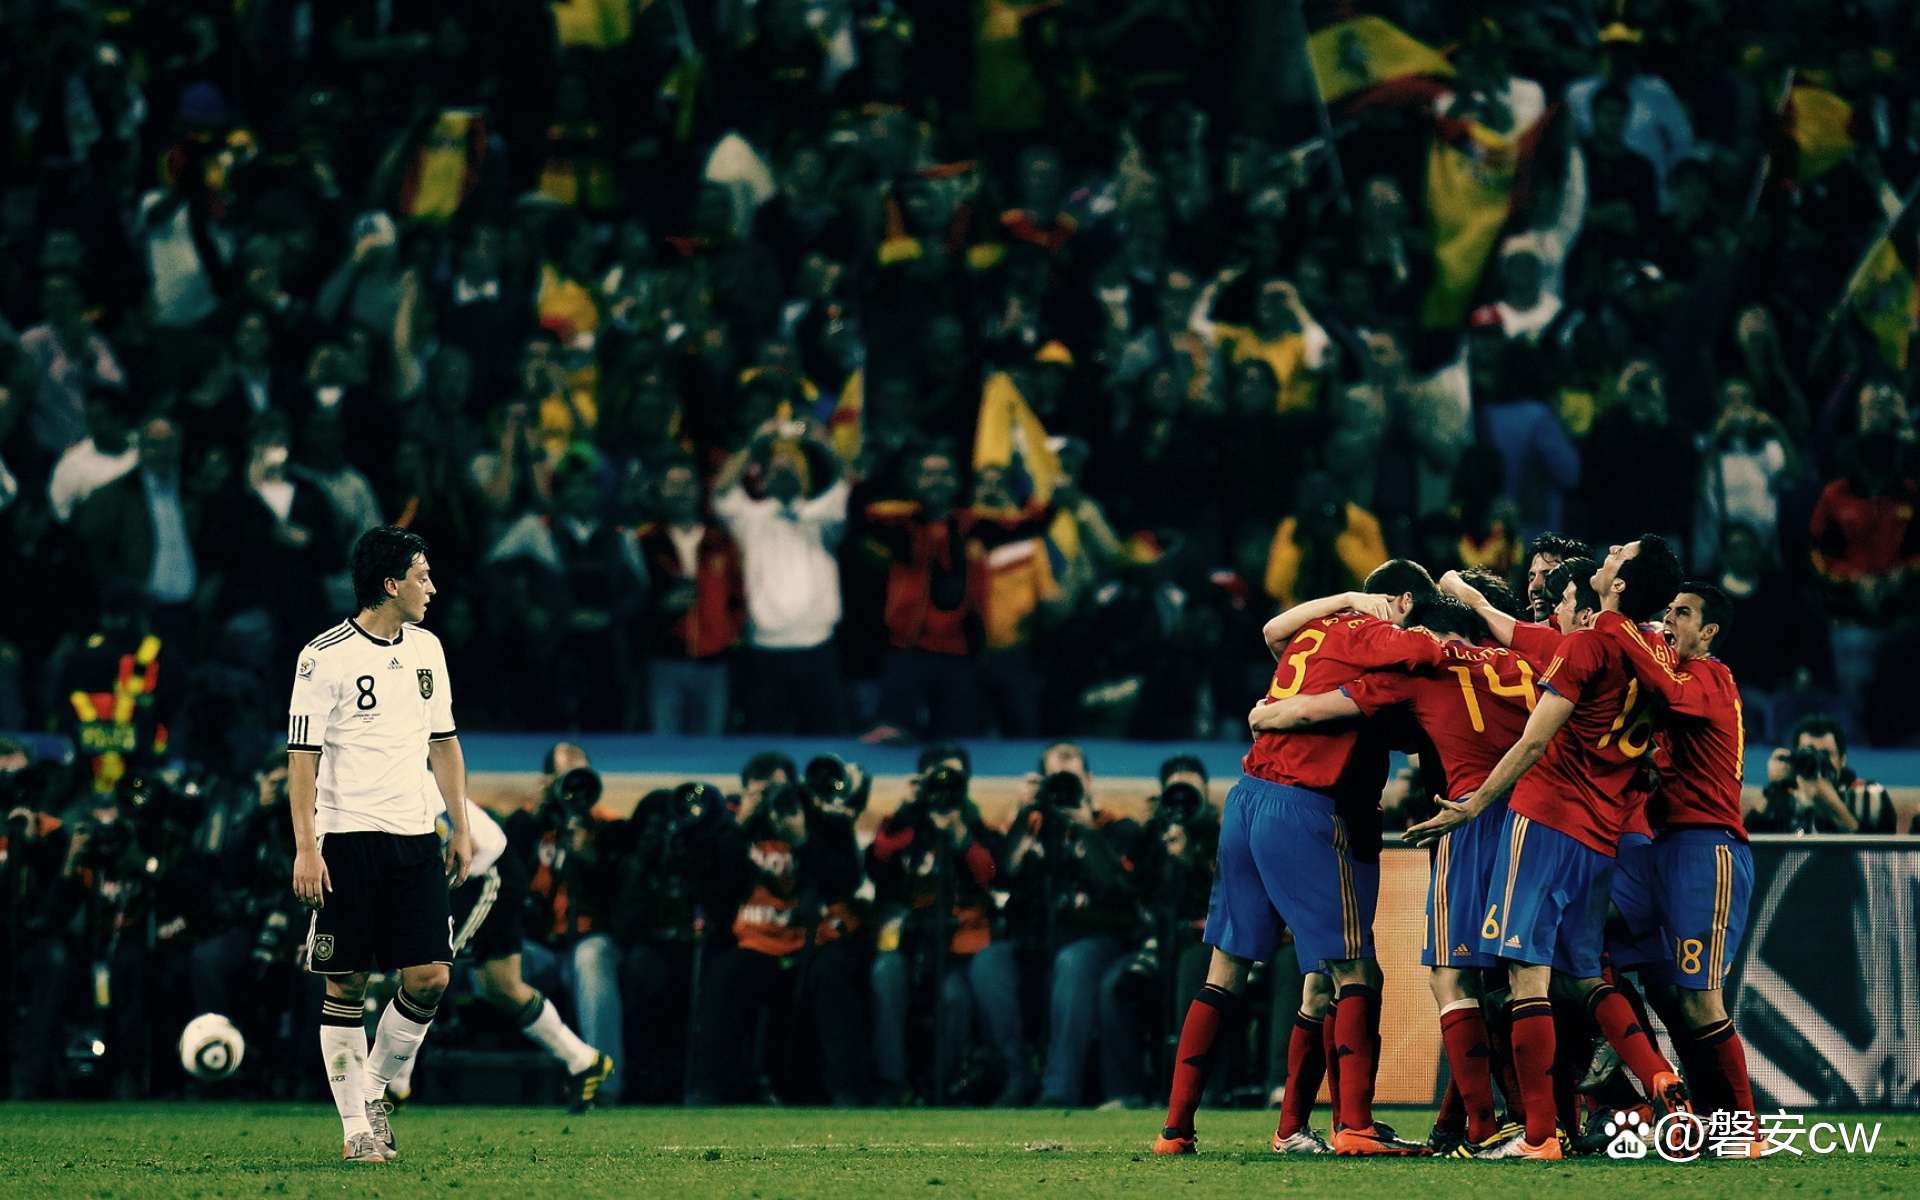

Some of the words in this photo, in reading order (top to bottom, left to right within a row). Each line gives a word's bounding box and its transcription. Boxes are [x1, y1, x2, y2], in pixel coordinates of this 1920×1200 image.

[356, 675, 377, 710] 8
[1270, 628, 1327, 700] 3
[1447, 659, 1537, 733] 14
[1596, 677, 1652, 759] 16
[1733, 698, 1745, 780] 1
[1481, 903, 1500, 939] 6
[1675, 936, 1704, 975] 18
